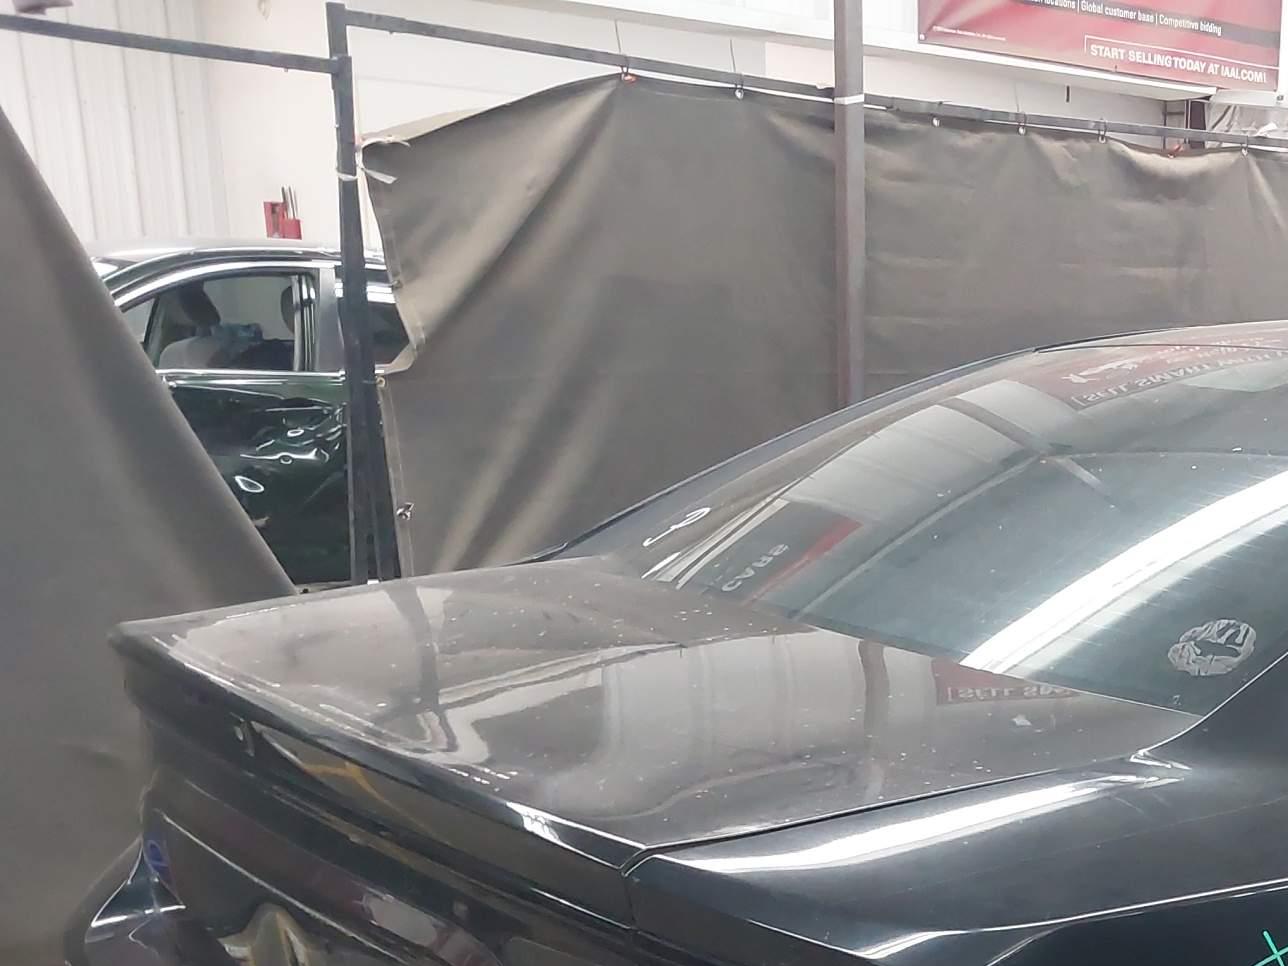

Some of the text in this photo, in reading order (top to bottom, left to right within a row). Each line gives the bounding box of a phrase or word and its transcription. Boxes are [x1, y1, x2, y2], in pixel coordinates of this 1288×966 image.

[1081, 1, 1104, 13] Global
[1104, 6, 1137, 20] customer
[1138, 12, 1154, 24] base
[1159, 15, 1199, 30] Competitive
[1200, 19, 1222, 36] bidding
[1090, 44, 1125, 60] START
[1128, 48, 1171, 68] SELLING
[1171, 55, 1207, 73] TODAY
[1207, 62, 1220, 76] AT
